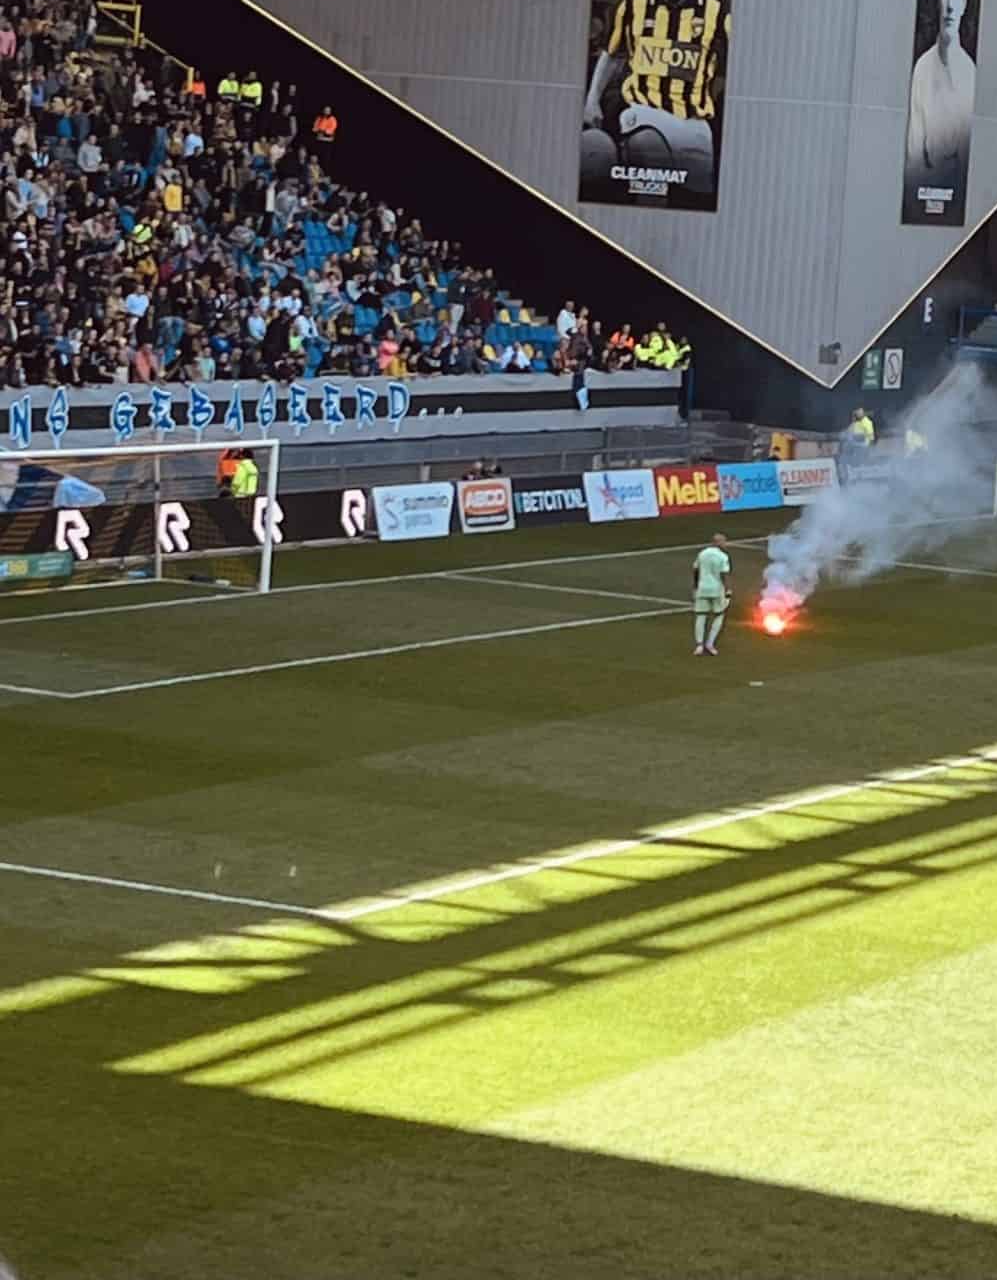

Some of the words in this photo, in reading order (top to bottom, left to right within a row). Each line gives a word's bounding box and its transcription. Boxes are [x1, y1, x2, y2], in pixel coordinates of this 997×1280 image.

[611, 165, 688, 183] CLEANMAT
[657, 472, 720, 507] Melis
[158, 501, 190, 553] R
